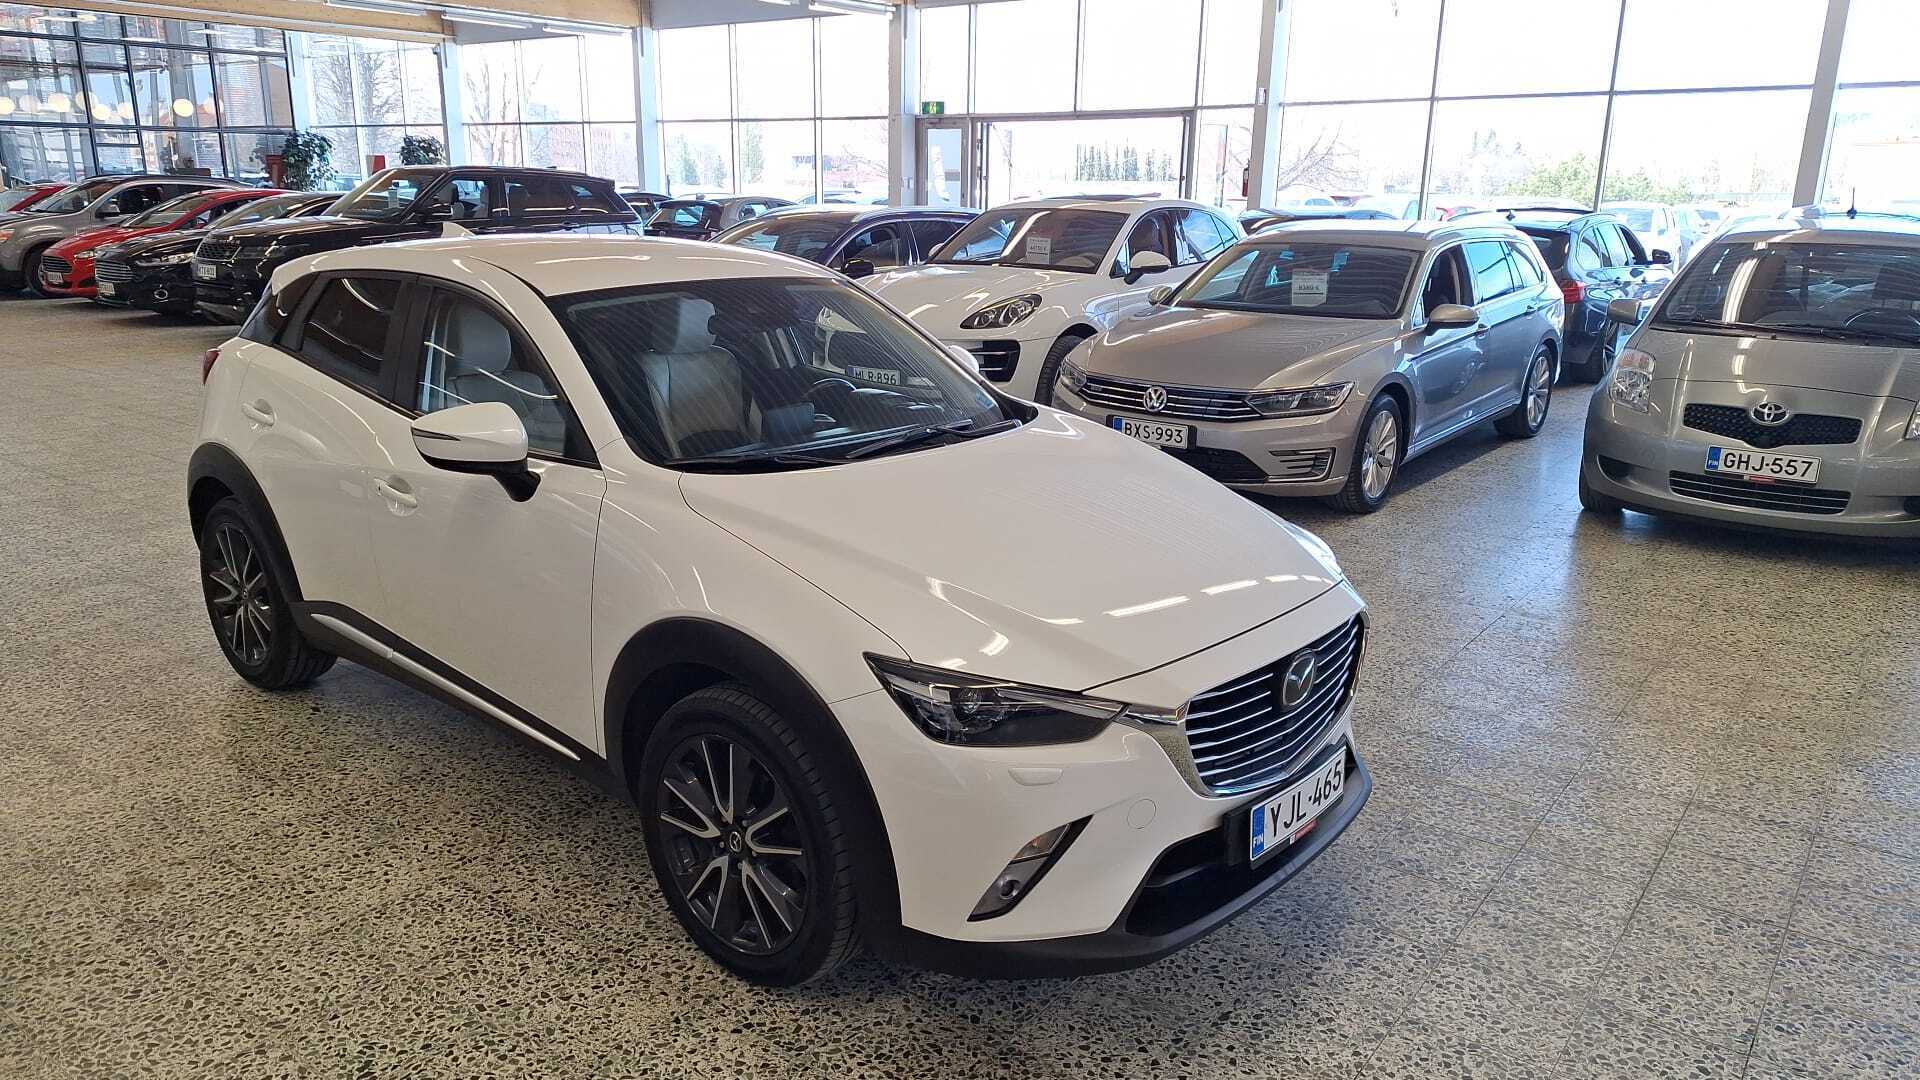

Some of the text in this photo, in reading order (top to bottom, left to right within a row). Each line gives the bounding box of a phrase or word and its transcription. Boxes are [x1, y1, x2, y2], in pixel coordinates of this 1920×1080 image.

[1124, 422, 1183, 444] BXS-993
[1723, 452, 1813, 477] GHJ-557
[1270, 759, 1342, 837] YJL-465
[1253, 833, 1264, 848] FIN
